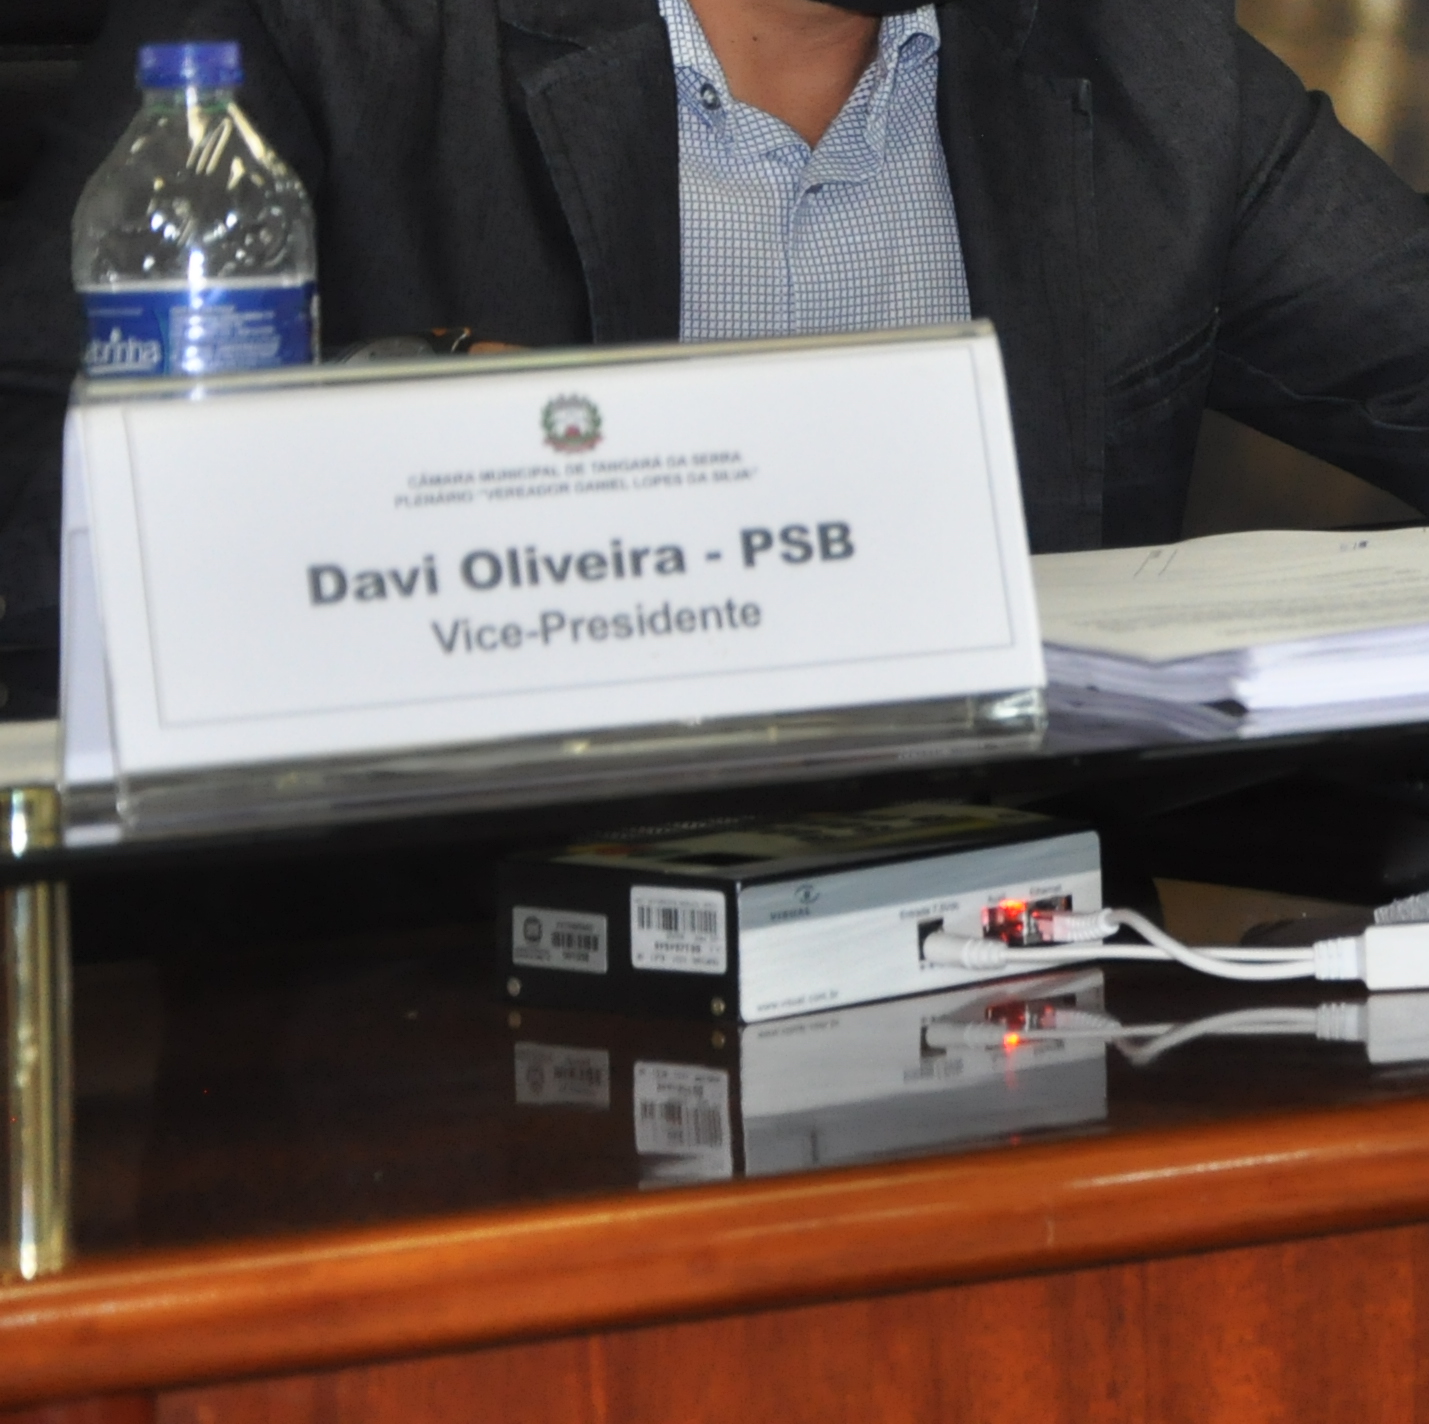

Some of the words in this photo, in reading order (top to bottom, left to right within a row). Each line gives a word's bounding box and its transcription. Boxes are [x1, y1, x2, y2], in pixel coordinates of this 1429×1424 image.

[306, 555, 440, 607] Davi
[459, 539, 686, 592] Oliveira
[739, 519, 856, 569] PSB
[430, 596, 763, 656] Vice-Presidente
